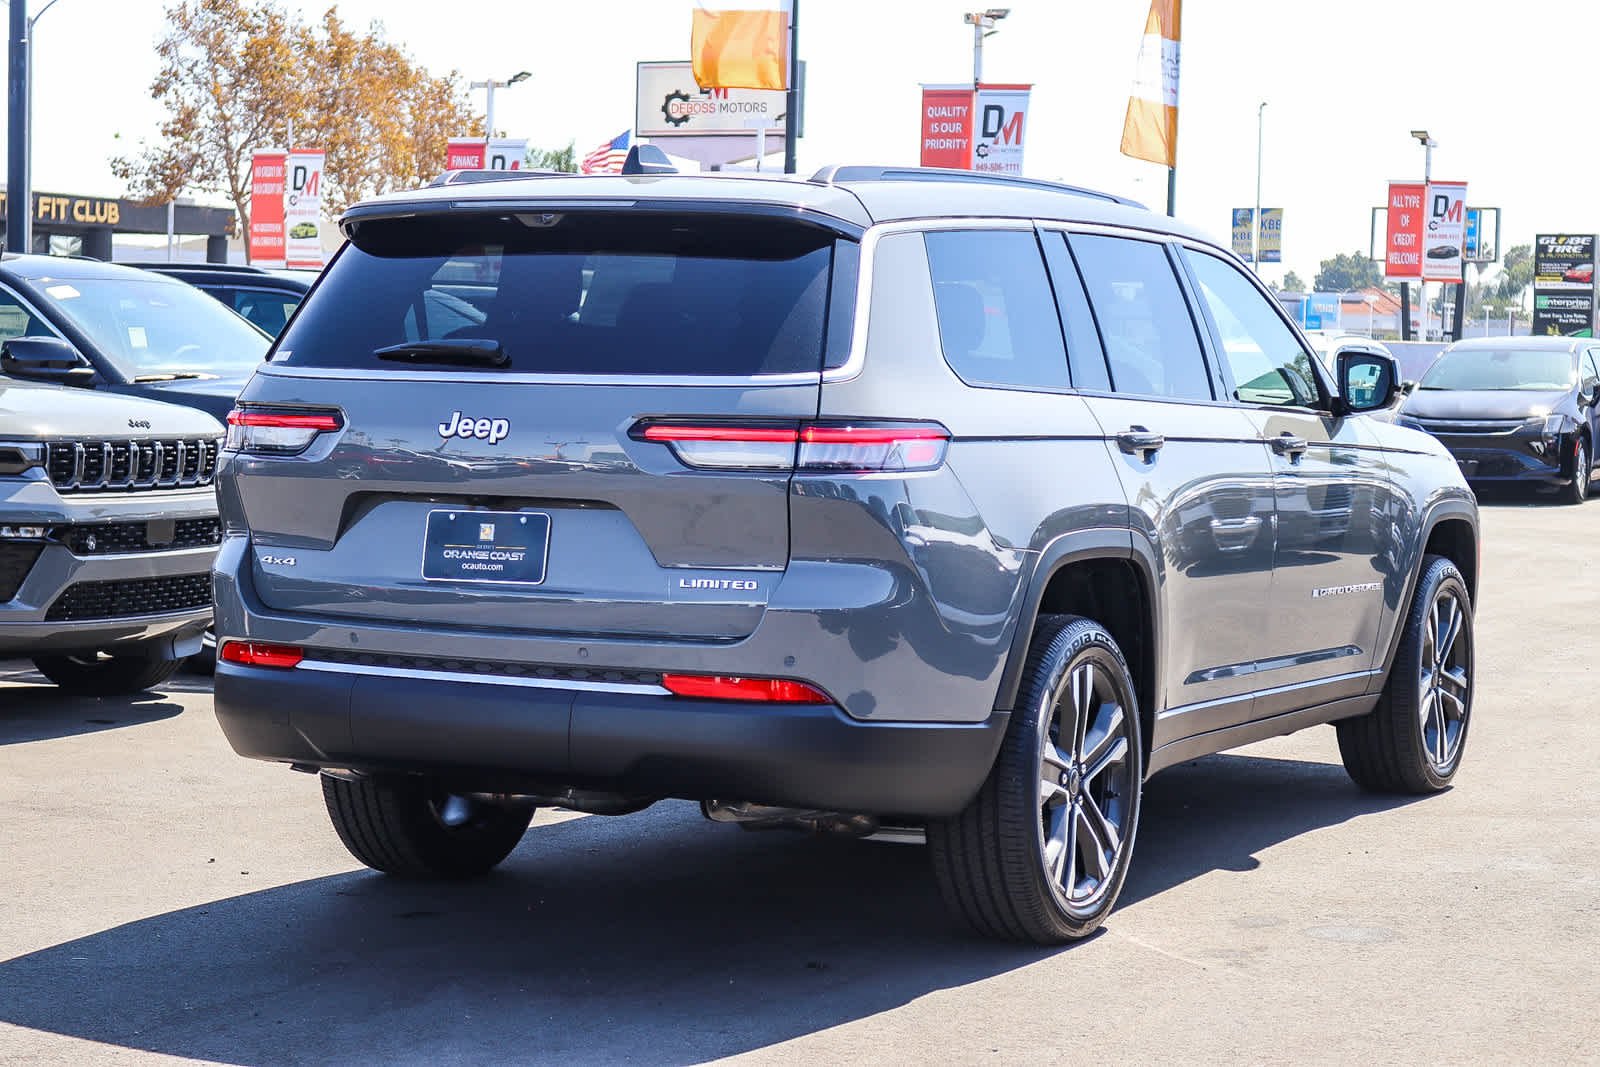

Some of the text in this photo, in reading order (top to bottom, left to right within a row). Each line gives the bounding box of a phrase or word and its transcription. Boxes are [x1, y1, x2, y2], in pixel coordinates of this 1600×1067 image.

[671, 101, 768, 114] DEBOSS MOTORS
[927, 105, 968, 118] QUALITY
[931, 122, 963, 133] IS OUR
[925, 138, 968, 150] PRIORITY
[451, 154, 480, 168] FINANCE
[293, 165, 320, 197] DM
[1392, 195, 1421, 209] ALL TYPE
[38, 196, 70, 220] FIT
[73, 199, 120, 224] CLUB
[1400, 214, 1410, 226] OF
[1393, 233, 1416, 247] CREDIT
[1547, 245, 1584, 254] TIRE
[1389, 252, 1420, 265] WELCOME
[128, 418, 151, 429] Jeep
[438, 410, 510, 445] Jeep
[262, 555, 297, 567] 4x4
[443, 549, 525, 561] ORANGE COAST
[461, 562, 504, 572] ocauto.com
[679, 578, 758, 590] LIMITED
